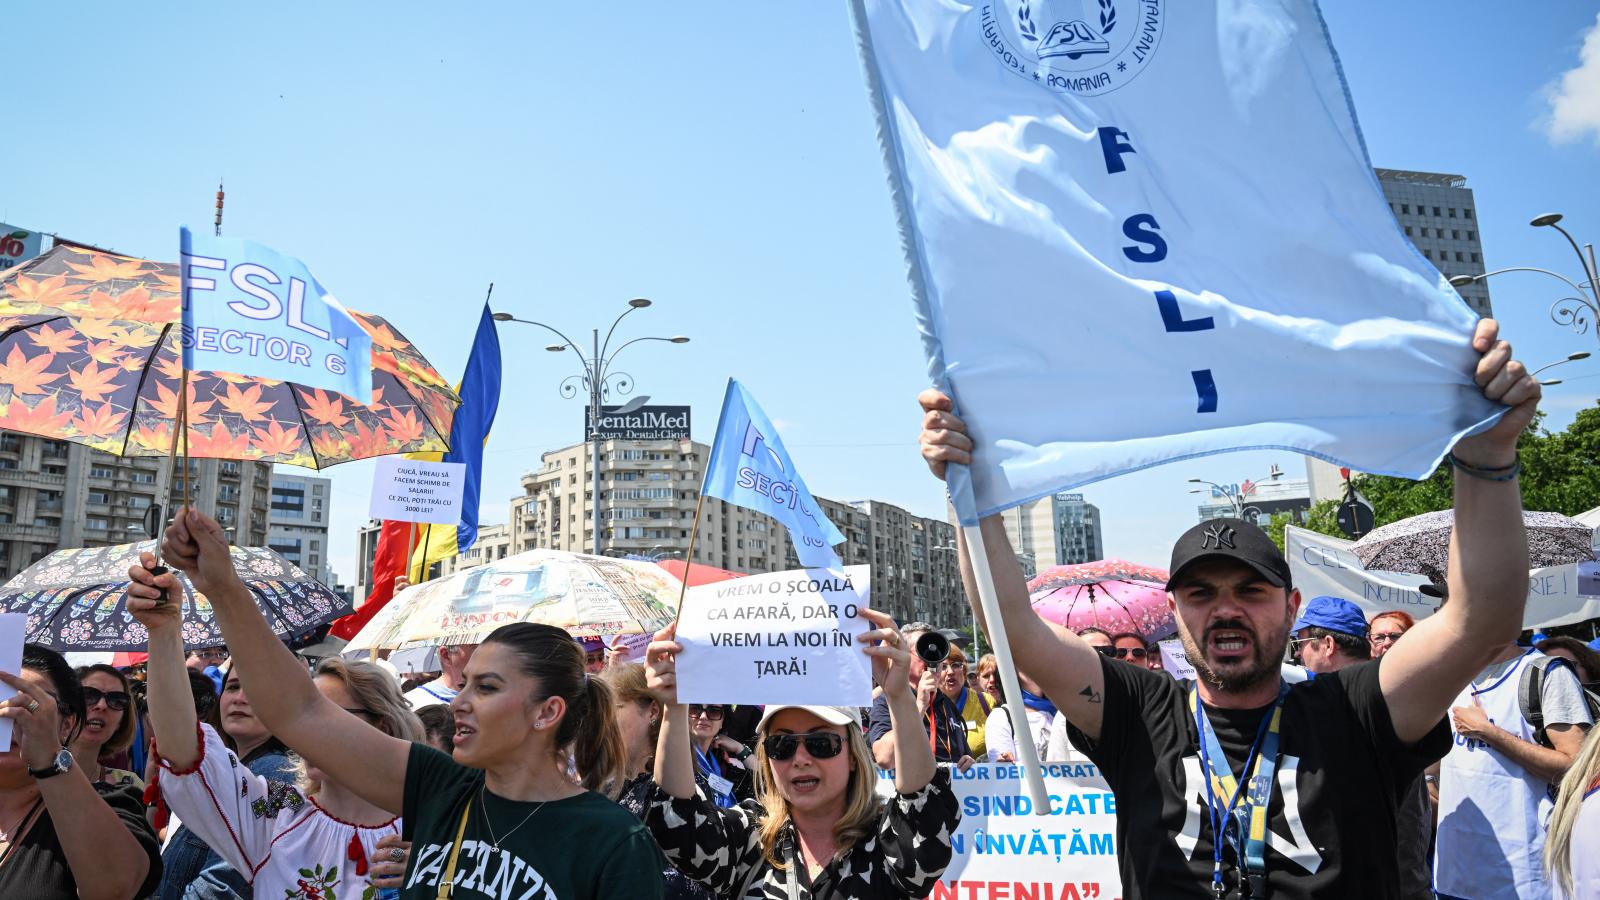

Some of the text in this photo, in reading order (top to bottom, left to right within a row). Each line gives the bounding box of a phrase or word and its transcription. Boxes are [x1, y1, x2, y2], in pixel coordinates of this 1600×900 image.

[1046, 24, 1095, 45] FSLI
[1047, 72, 1111, 92] ROMANIA
[181, 252, 348, 350] FSL
[182, 323, 346, 375] SECTOR 6
[587, 430, 623, 441] xury
[393, 476, 416, 484] FACEM
[417, 479, 441, 487] SCHIMB
[397, 468, 417, 476] CIUCĂ,
[717, 574, 854, 599] VREM O ȘCOALĂ
[707, 602, 858, 622] CA AFARĂ, DAR O
[711, 629, 852, 647] VREM LA NOI ÎN
[754, 657, 807, 678] ȚARĂ!
[995, 764, 1104, 780] DEOCRAT
[963, 792, 1116, 817] SINDCATE
[406, 840, 558, 900] VACANZ
